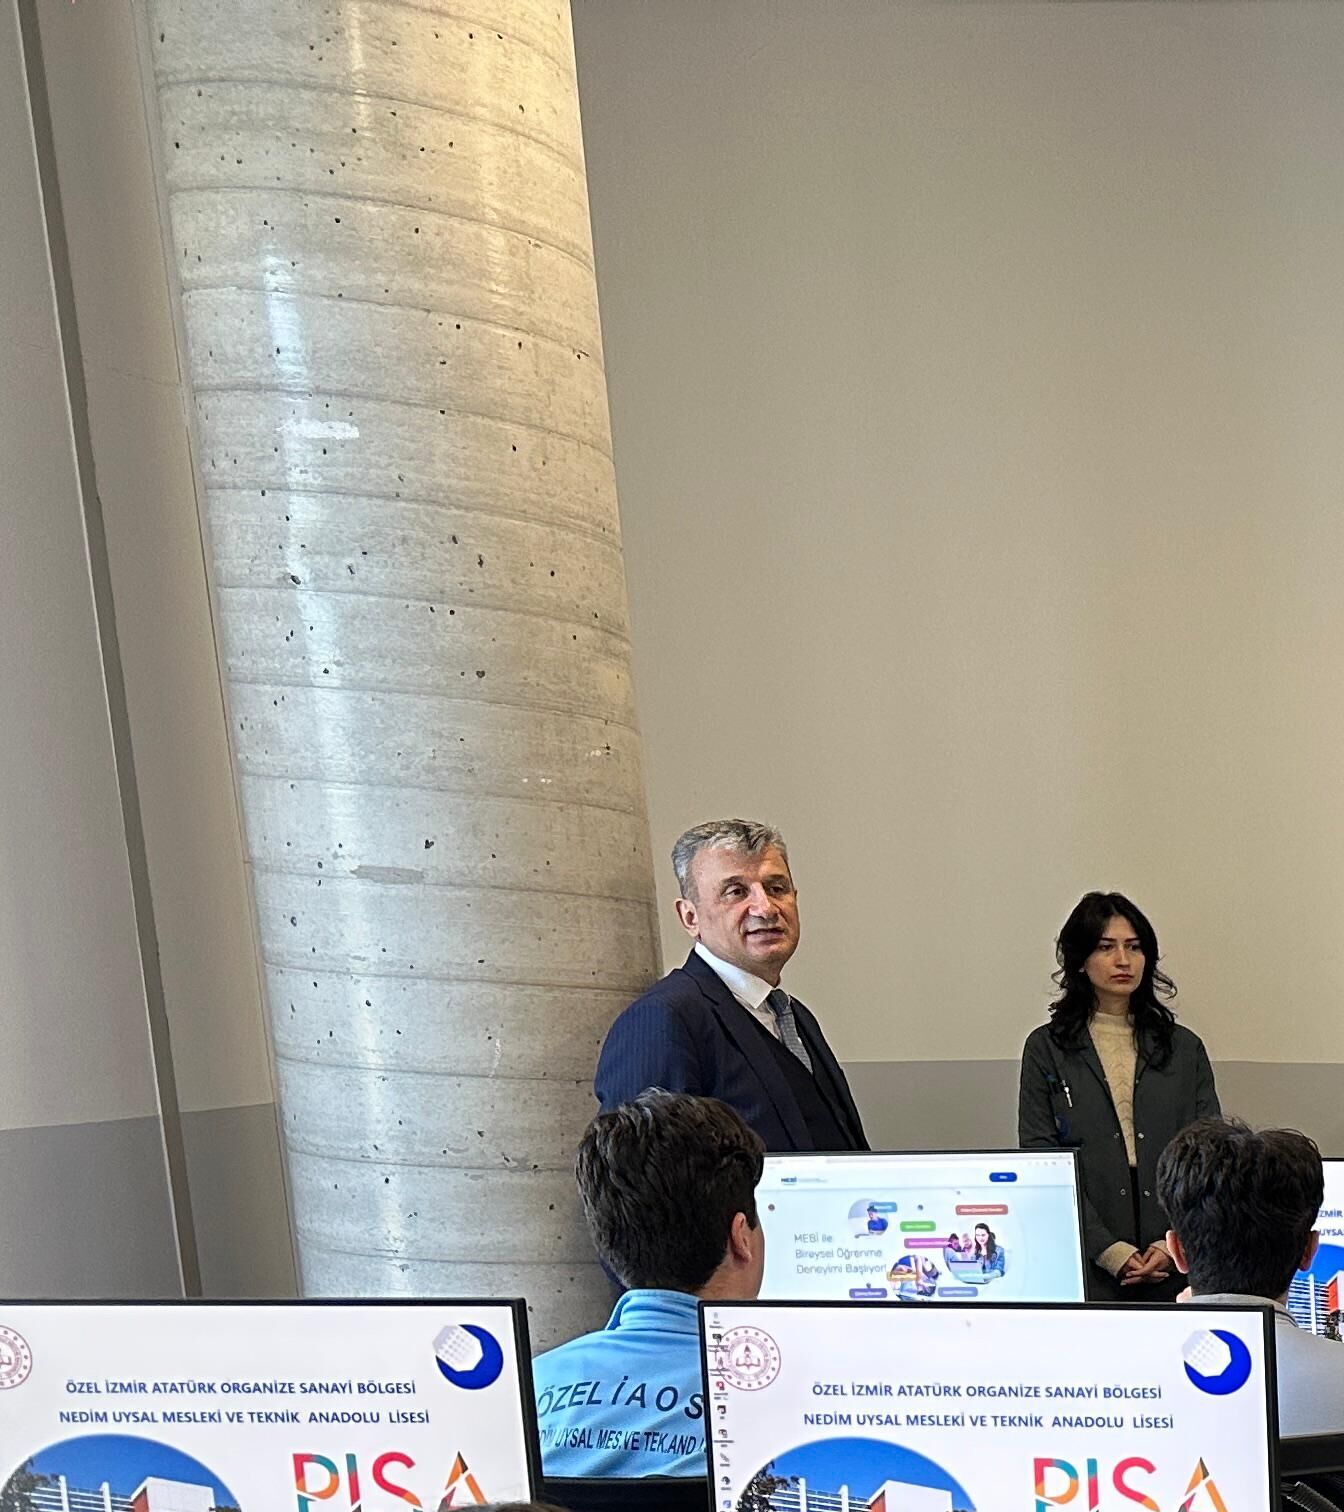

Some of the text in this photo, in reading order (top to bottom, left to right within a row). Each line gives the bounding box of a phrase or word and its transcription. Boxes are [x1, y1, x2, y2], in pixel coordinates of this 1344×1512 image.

[1318, 1208, 1343, 1218] ZMİR
[795, 1248, 883, 1260] Bireysel Öğrenme
[796, 1265, 842, 1275] Deneyimi
[66, 1379, 416, 1394] ÖZEL İZMİR ATATÜRK ORGANİZE SANAYİ BÖLGESİ
[812, 1382, 1162, 1399] ÖZEL İZMİR ATATÜRK ORGANİZE SANAYİ BÖLGESİ
[538, 1381, 602, 1418] ÖZEL
[59, 1409, 430, 1423] NEDİM UYSAL MESLEKİ VE TEKNİK ANADOLU LİSESİ
[803, 1411, 1174, 1429] NEDİM UYSAL MESLEKİ VE TEKNİK ANADOLU LİSESİ
